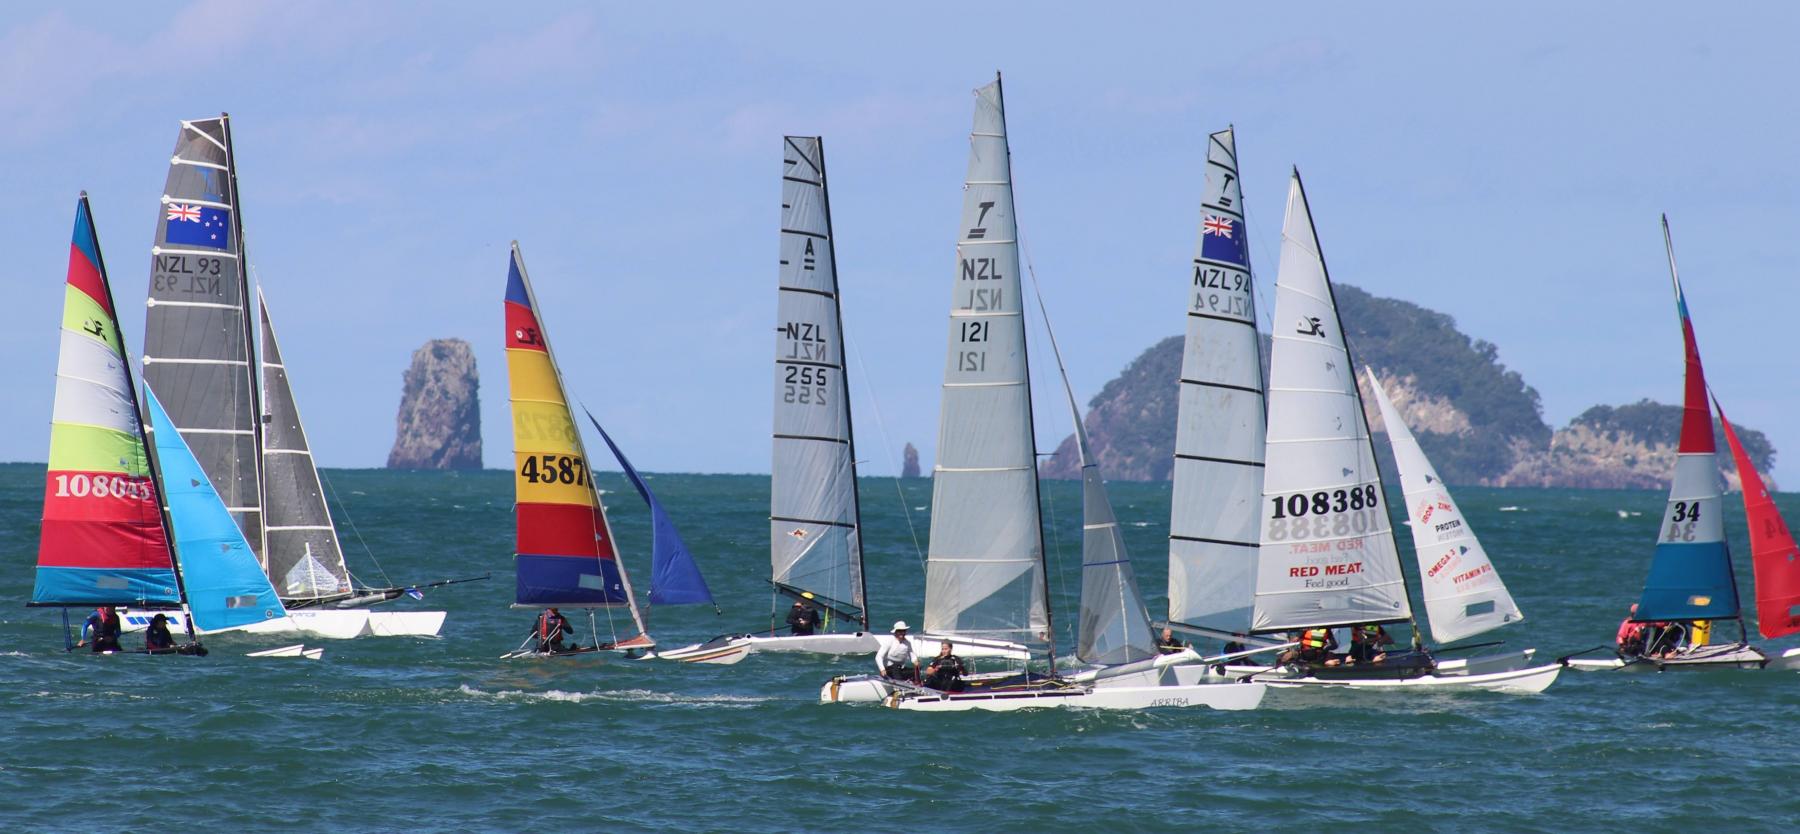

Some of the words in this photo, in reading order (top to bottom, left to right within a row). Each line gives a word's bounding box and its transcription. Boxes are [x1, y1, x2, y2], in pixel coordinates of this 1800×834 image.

[155, 255, 193, 274] NZL
[198, 257, 221, 275] 93
[962, 257, 1002, 281] NZL
[1194, 266, 1231, 291] NZL
[786, 322, 826, 343] NZL
[960, 321, 989, 343] 121
[785, 365, 827, 387] 255
[521, 455, 595, 487] 4587
[1271, 484, 1378, 519] 108388
[1672, 501, 1700, 522] 34
[1435, 519, 1462, 533] PROTEIN
[1289, 566, 1320, 578] RED
[1325, 562, 1365, 576] MEAT.
[1428, 554, 1451, 578] OMEGA
[1453, 569, 1482, 584] VITAMIN
[1304, 579, 1325, 588] Feel
[1151, 697, 1189, 707] ARRIBA
